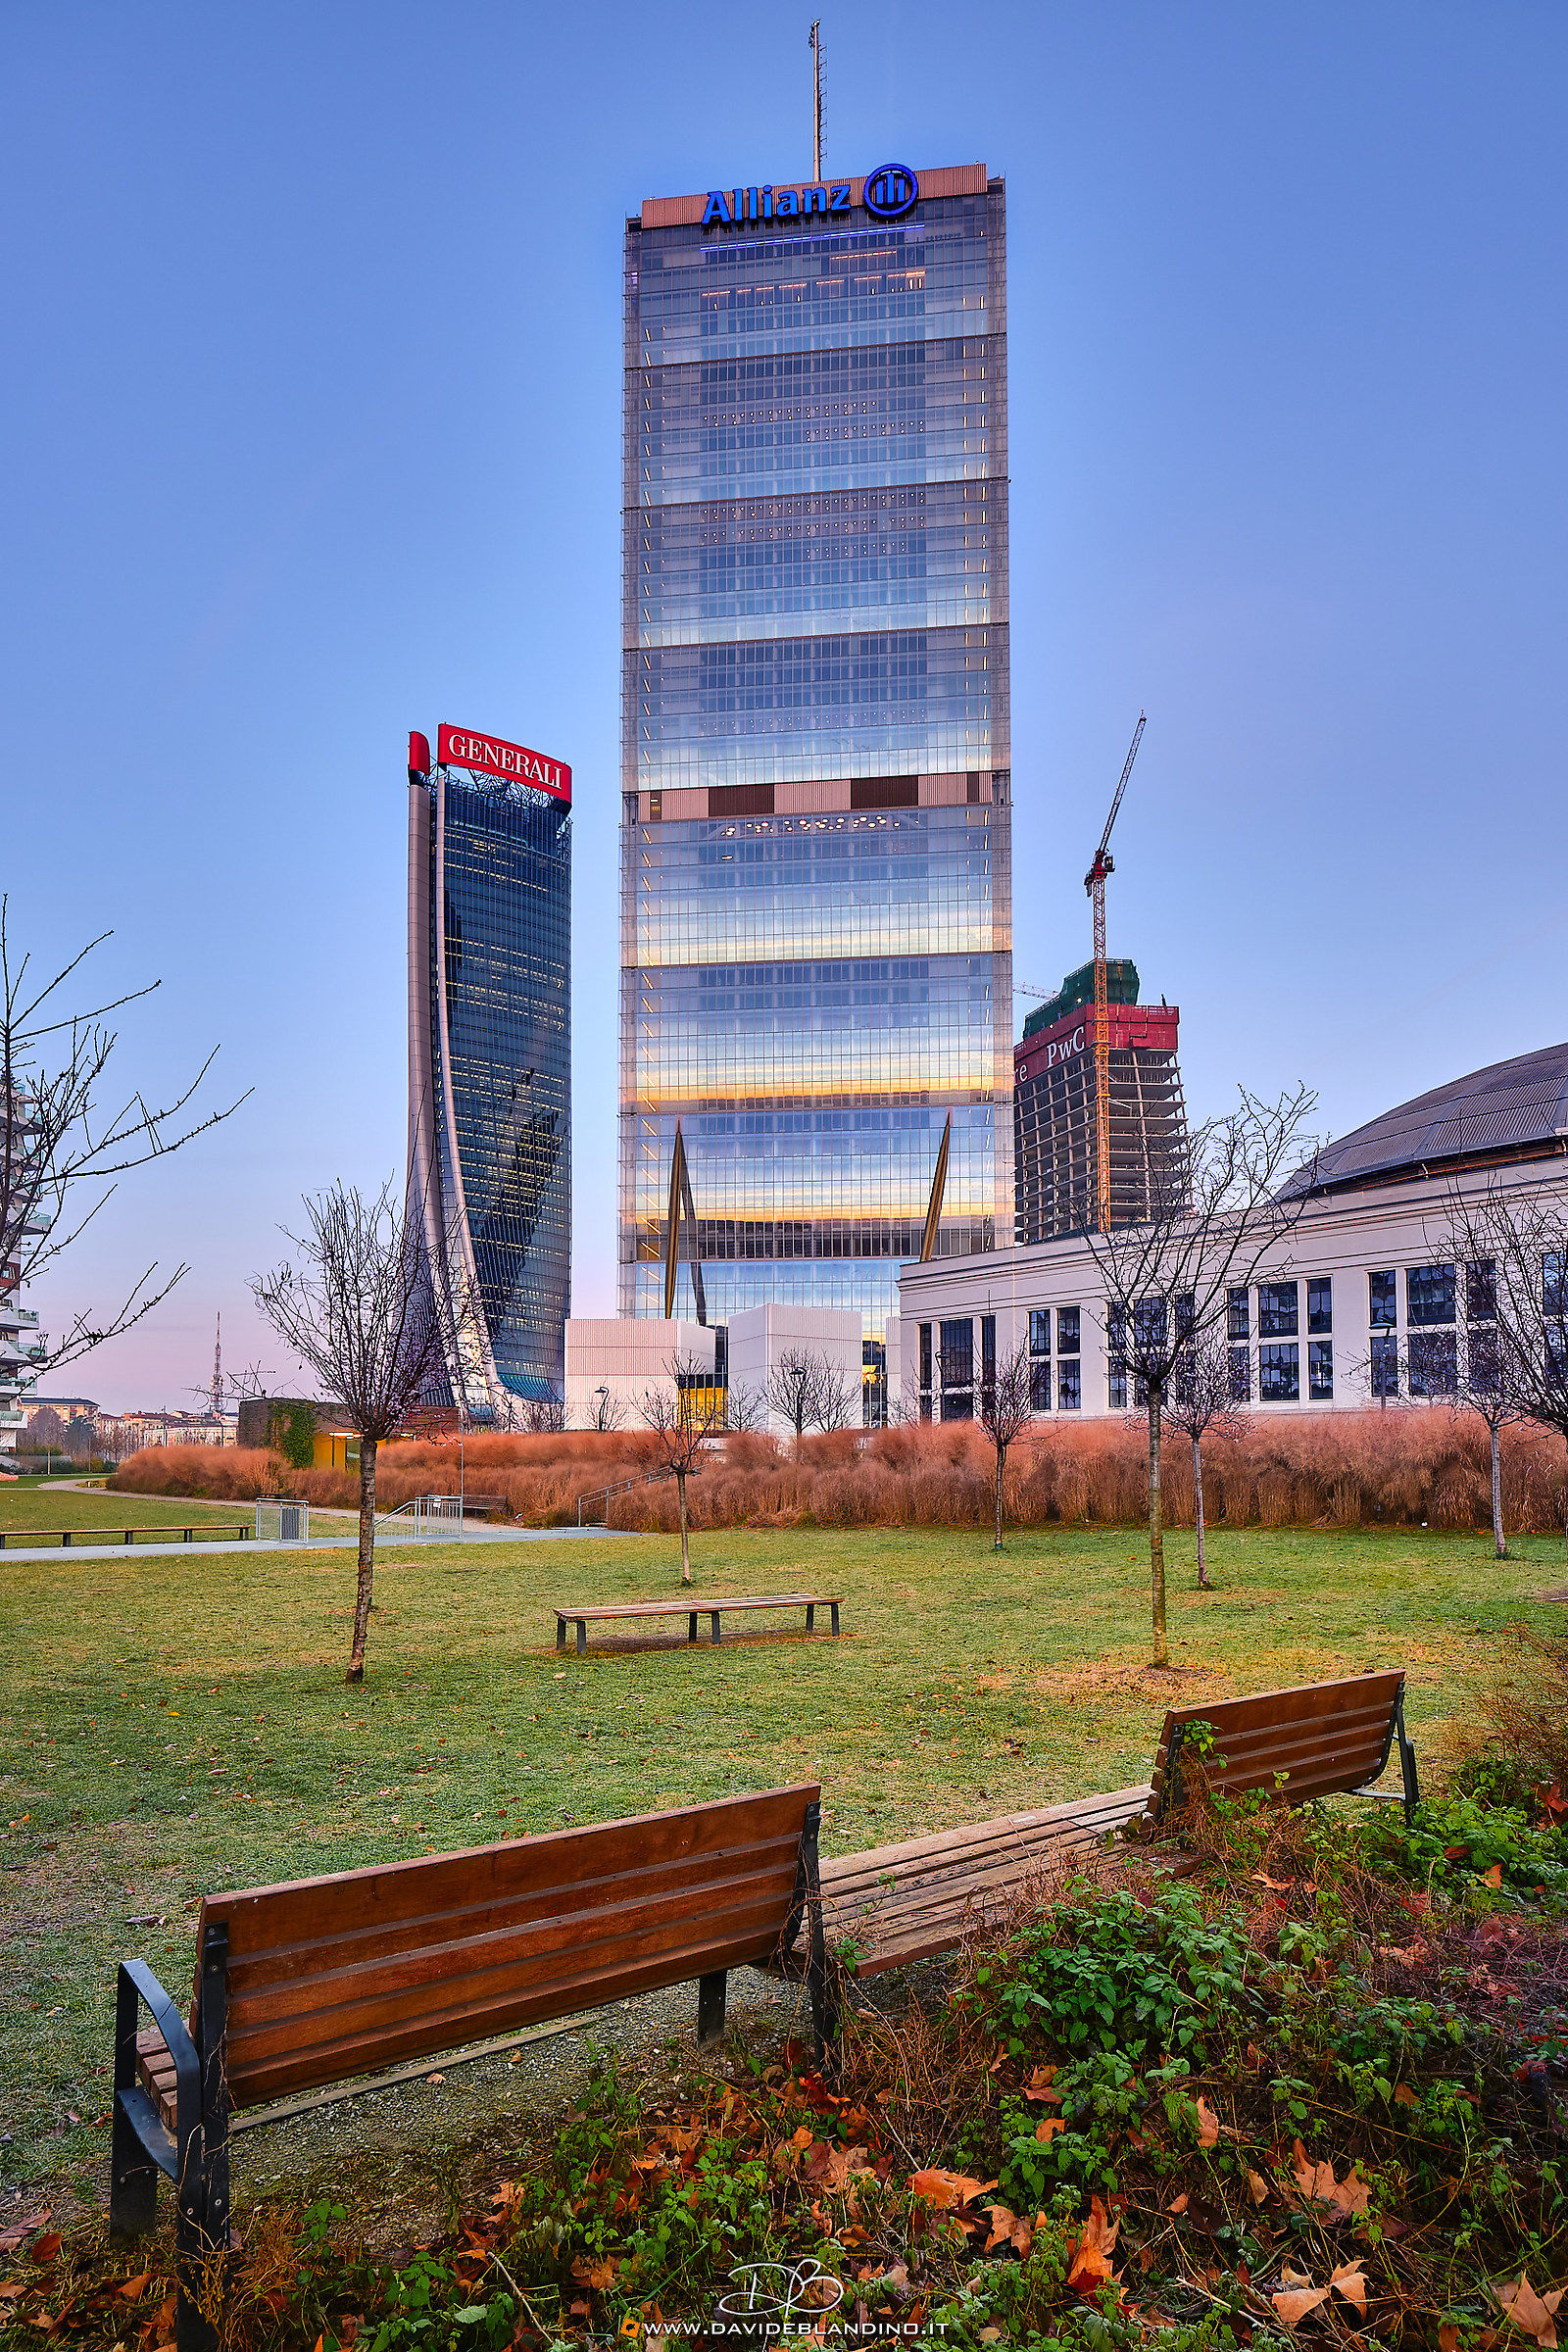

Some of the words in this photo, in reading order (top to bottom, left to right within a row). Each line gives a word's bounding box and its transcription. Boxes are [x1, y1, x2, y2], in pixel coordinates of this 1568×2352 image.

[702, 184, 852, 224] Allianz
[448, 734, 563, 790] GENERALI
[1046, 1026, 1085, 1069] PwC
